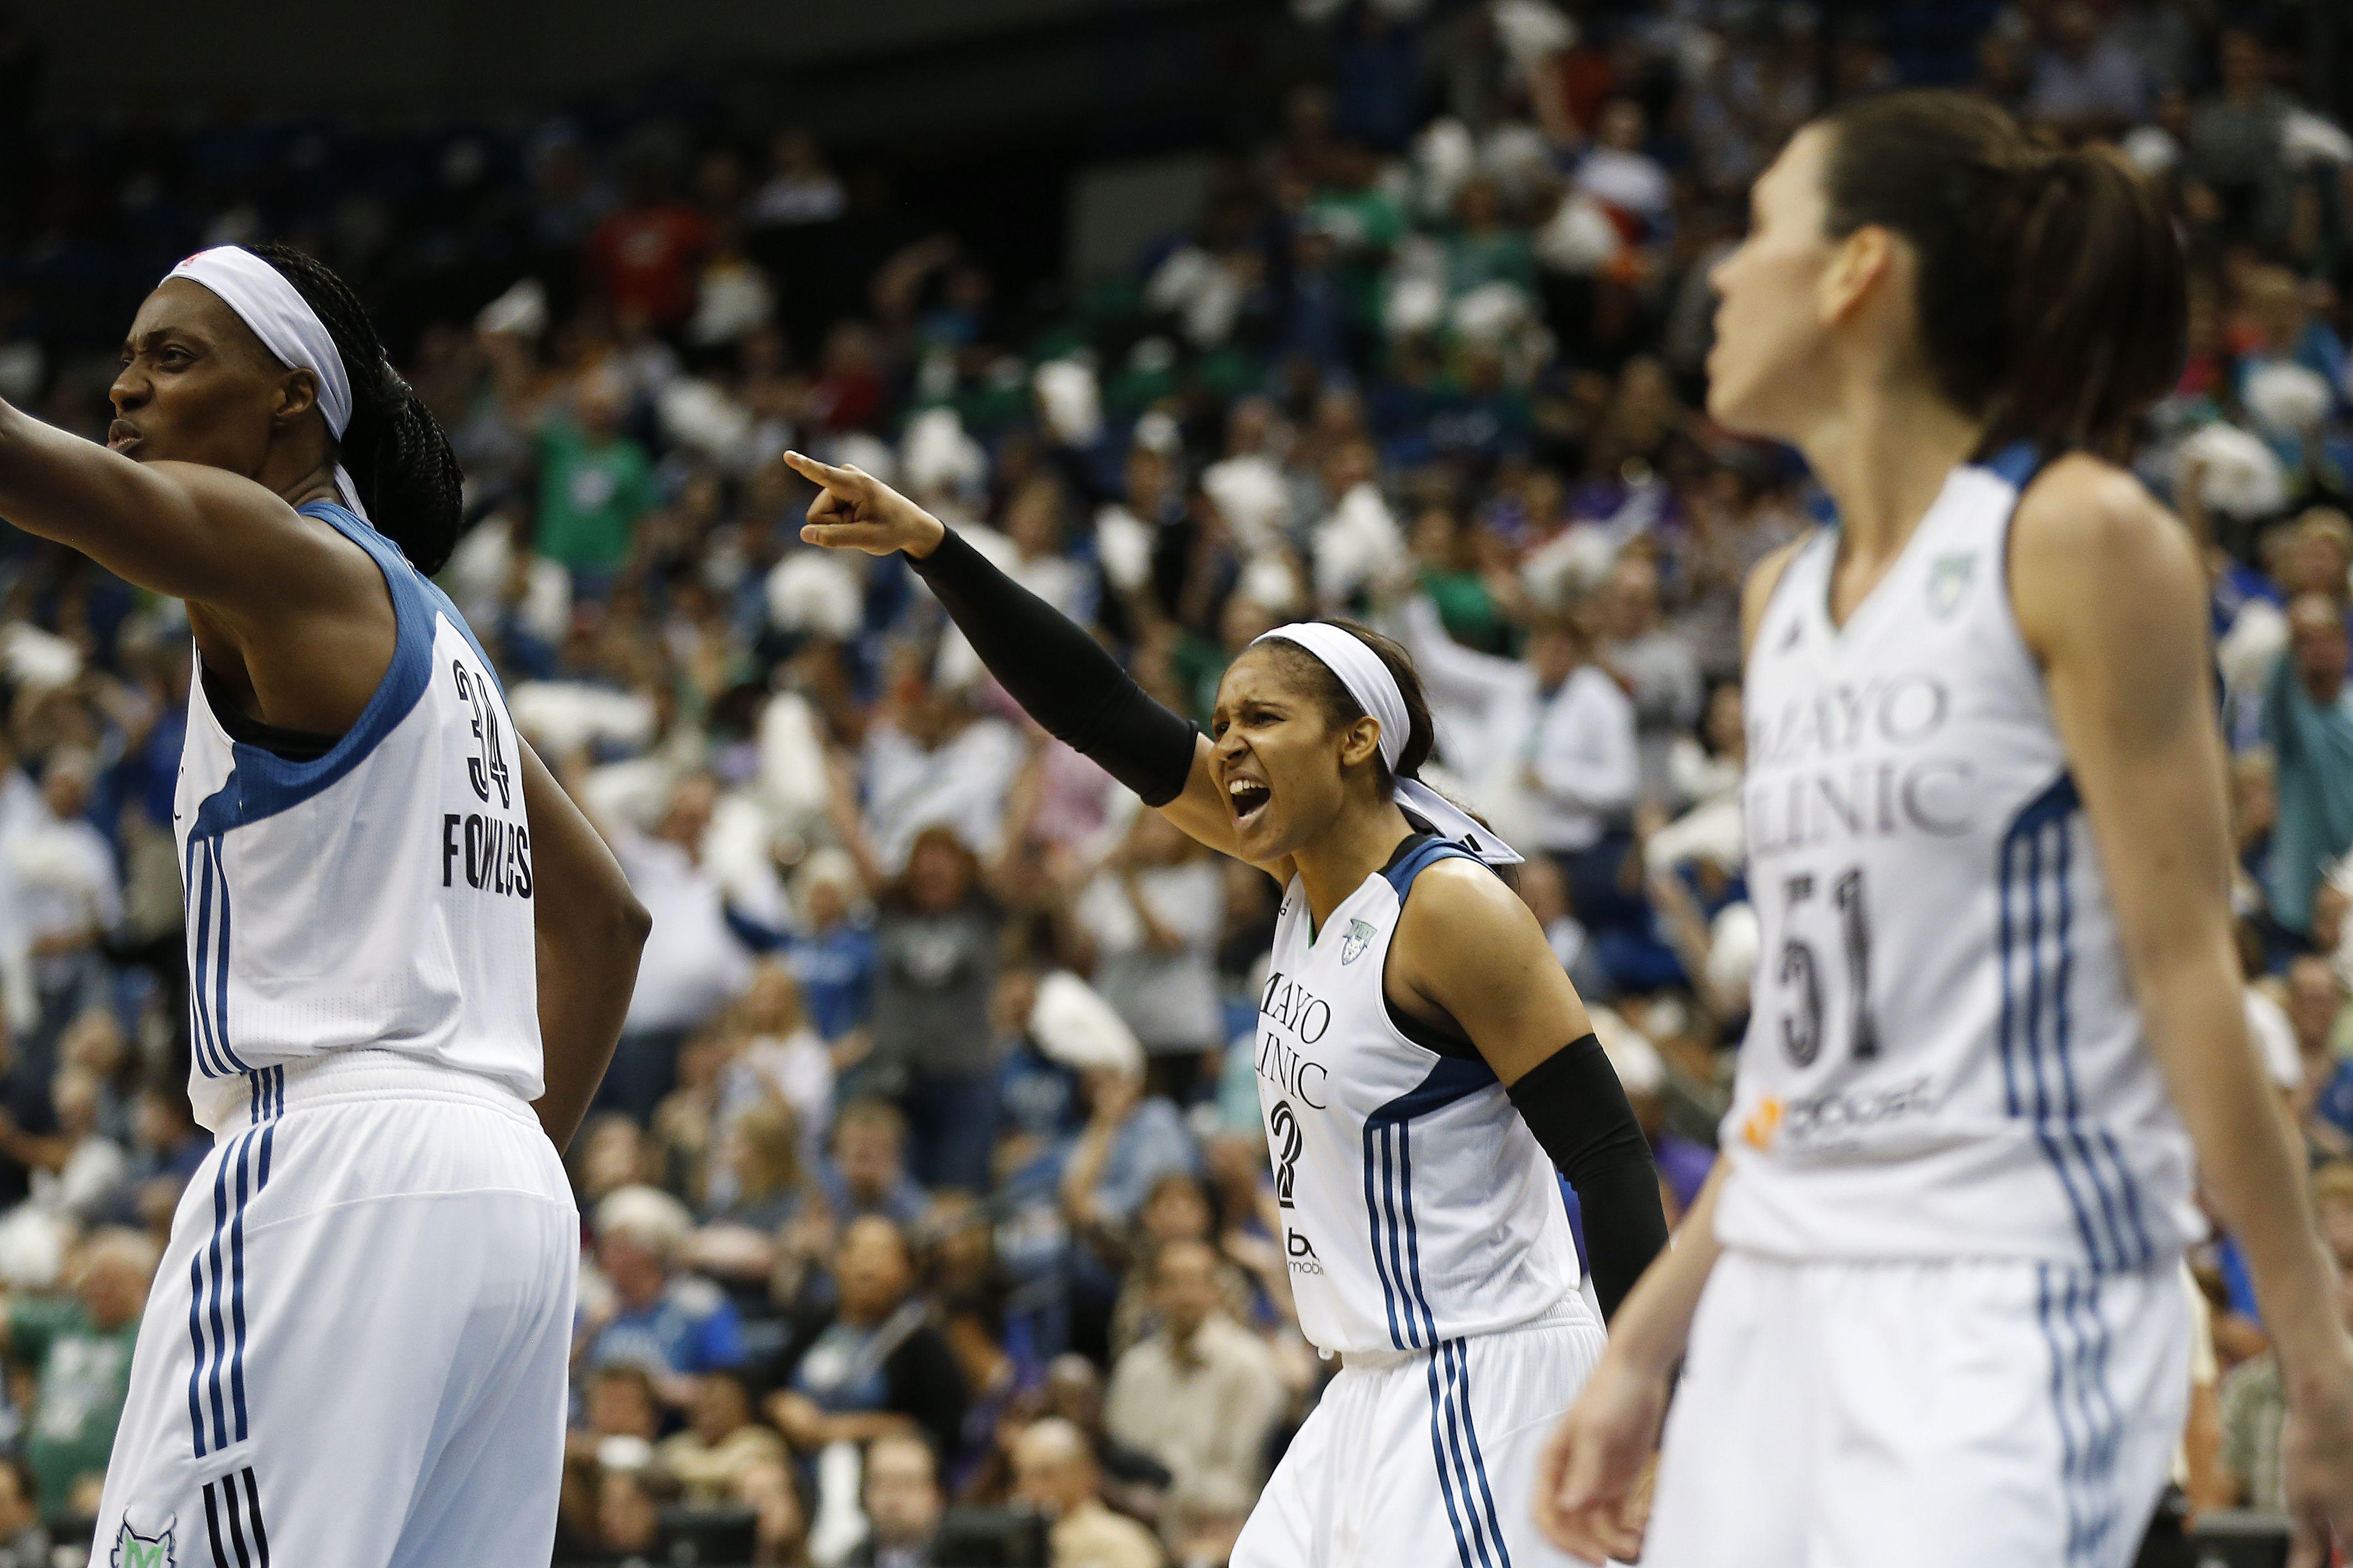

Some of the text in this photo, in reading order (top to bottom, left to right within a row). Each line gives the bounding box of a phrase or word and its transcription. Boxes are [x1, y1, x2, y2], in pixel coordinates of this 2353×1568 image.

[453, 659, 510, 810] 34
[443, 813, 533, 899] FOWLES
[1747, 756, 1977, 857] LINIC
[1780, 865, 1881, 1069] 51
[1255, 1031, 1328, 1109] INIC
